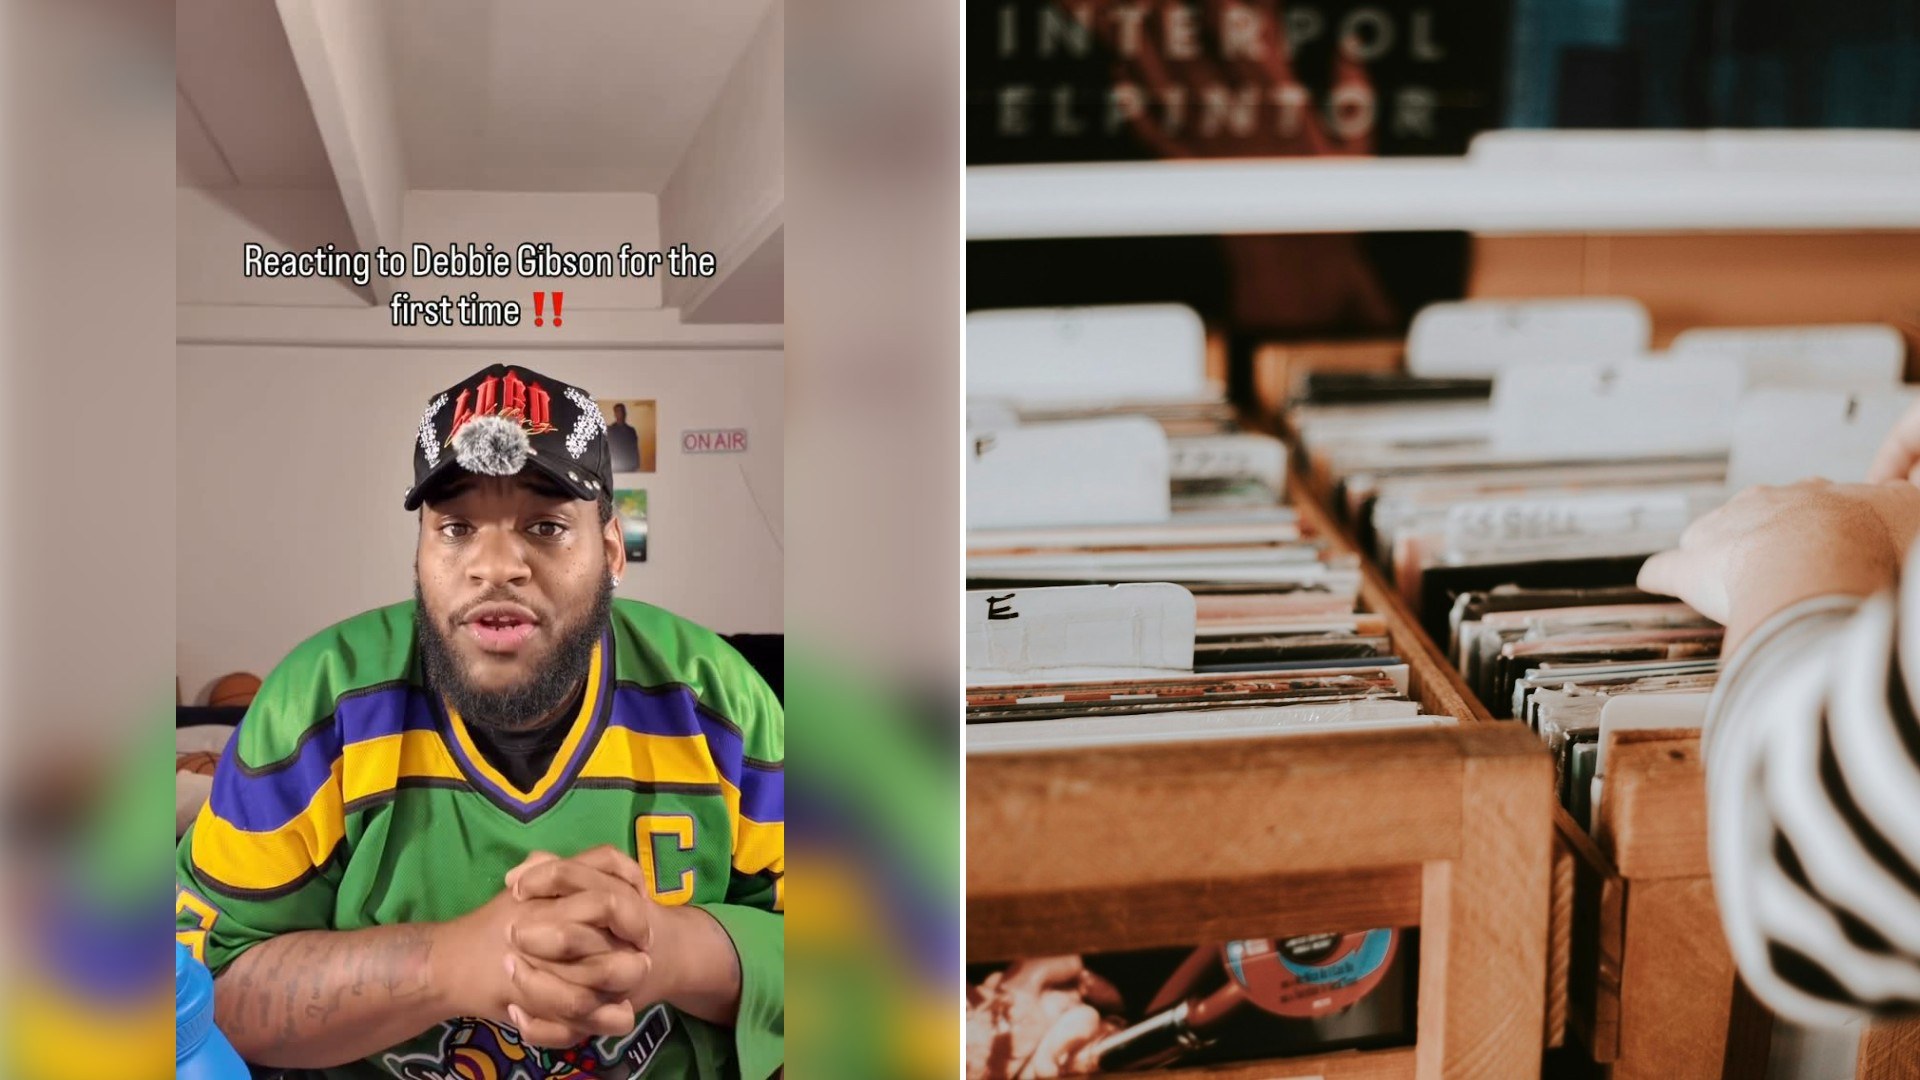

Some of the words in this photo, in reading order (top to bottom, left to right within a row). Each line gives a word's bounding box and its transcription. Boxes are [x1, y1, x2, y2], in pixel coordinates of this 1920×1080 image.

[999, 7, 1444, 60] INTERPOL
[684, 433, 710, 450] ON
[714, 432, 746, 450] AIR
[986, 593, 1019, 620] E
[633, 812, 696, 906] C
